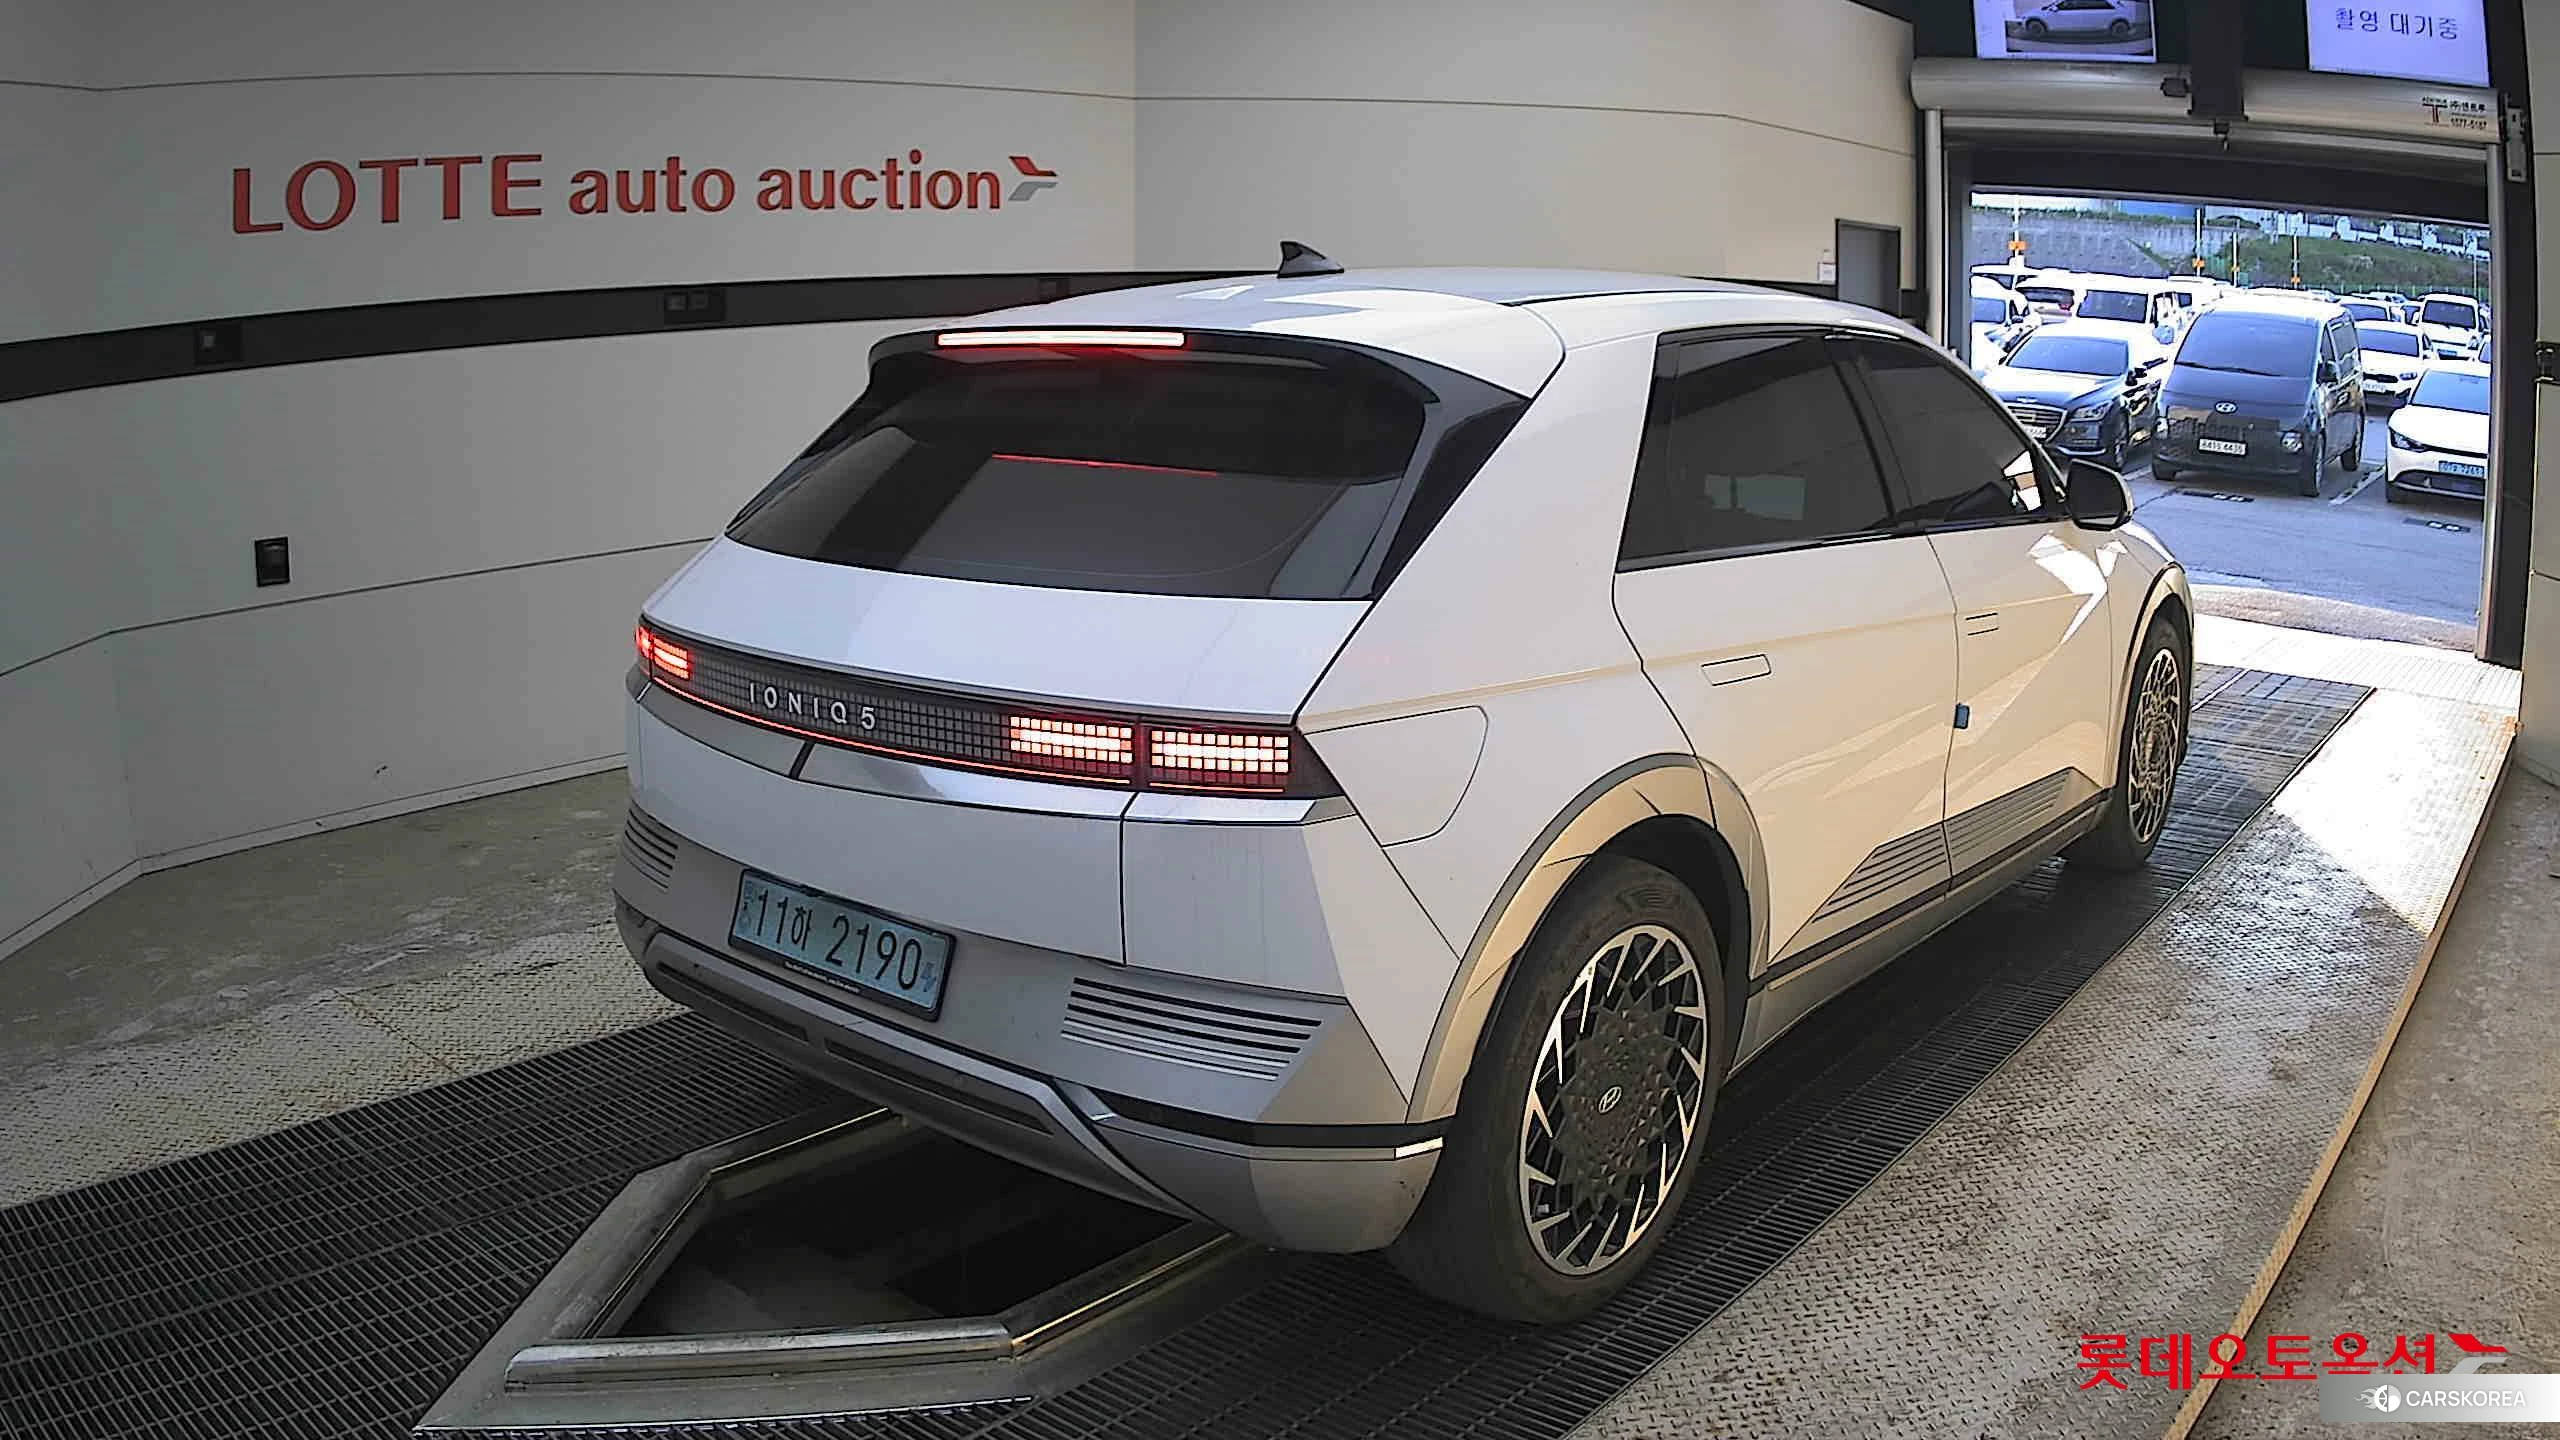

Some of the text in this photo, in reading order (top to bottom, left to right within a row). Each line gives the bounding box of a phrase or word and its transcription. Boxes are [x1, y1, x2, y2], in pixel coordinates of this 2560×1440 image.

[2390, 13, 2458, 40] 대기중
[232, 149, 1002, 235] LOTTE auto auction
[749, 682, 876, 731] IONIQ 5
[756, 889, 814, 951] 11하
[825, 914, 923, 991] 2190
